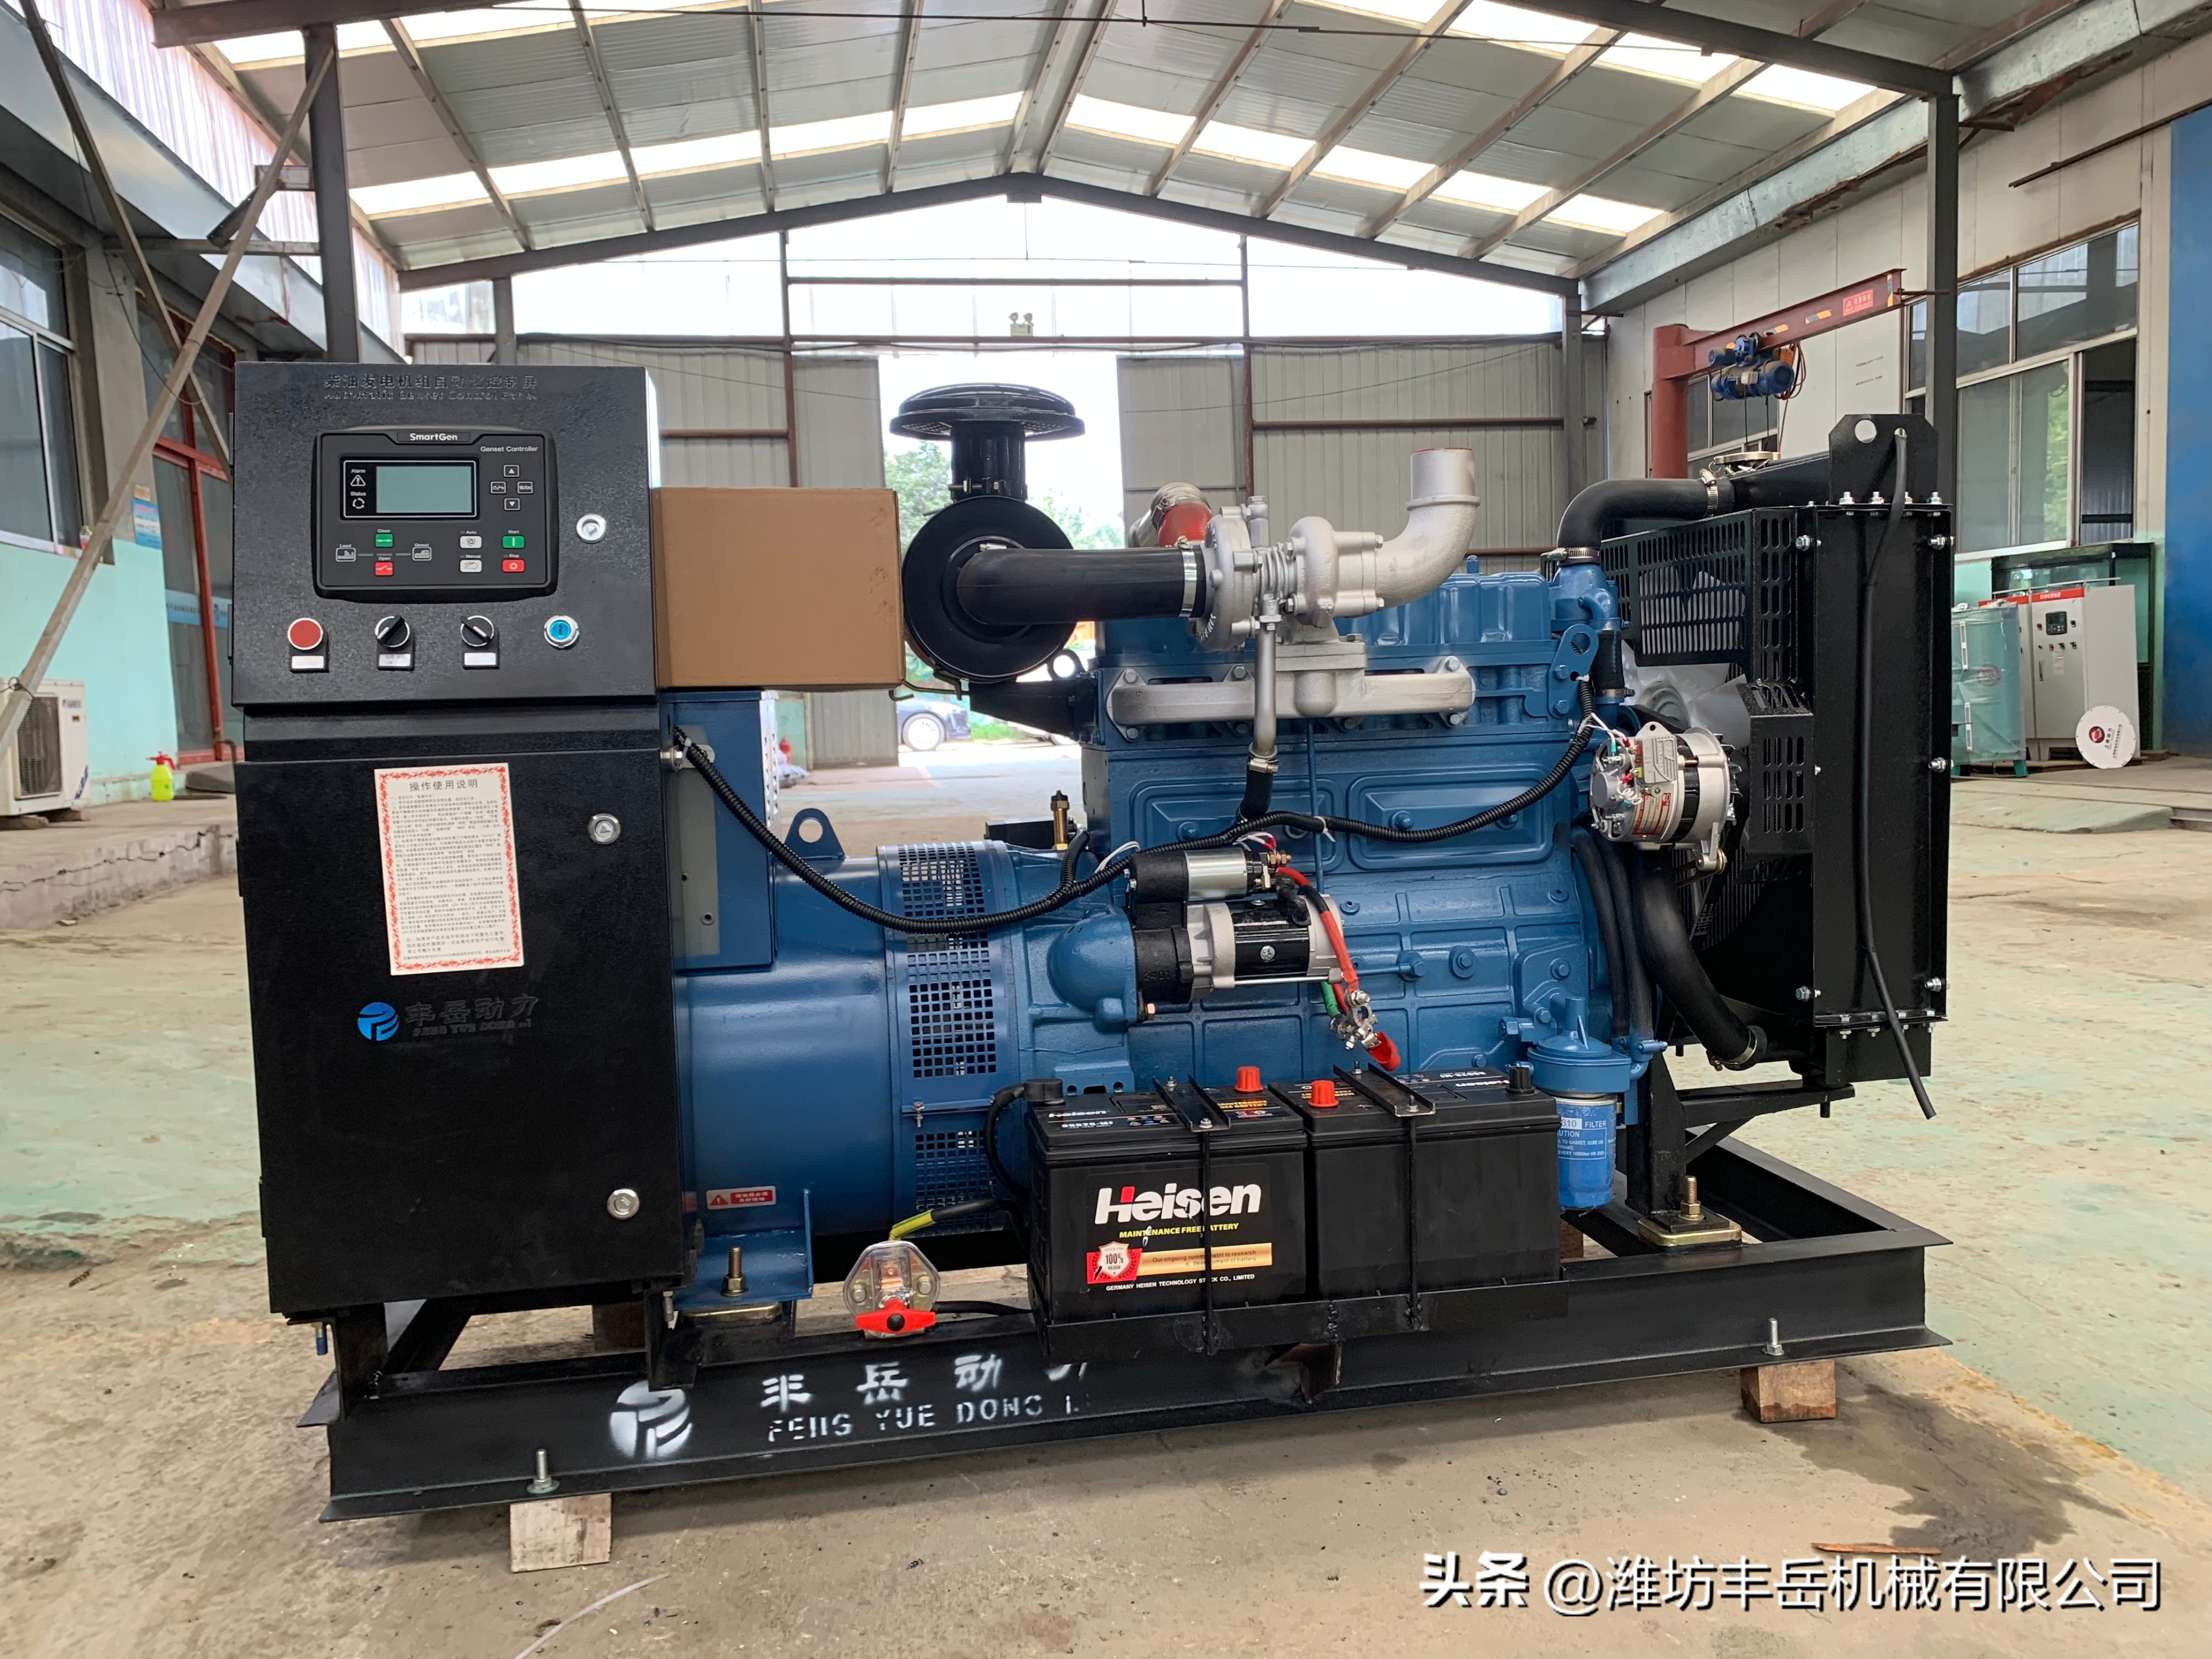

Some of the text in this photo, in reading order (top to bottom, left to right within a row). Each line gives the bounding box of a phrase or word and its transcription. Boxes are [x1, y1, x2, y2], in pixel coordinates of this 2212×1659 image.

[325, 390, 394, 401] Automatic
[409, 432, 458, 441] SmartGen
[409, 779, 479, 792] 操作使用说明
[1094, 1183, 1262, 1225] Heisen
[1119, 1227, 1181, 1238] MAINTENANCE
[1181, 1225, 1202, 1234] FREE
[1105, 1253, 1123, 1264] 100%
[1193, 1258, 1229, 1266] devepment
[875, 1405, 935, 1431] YUE
